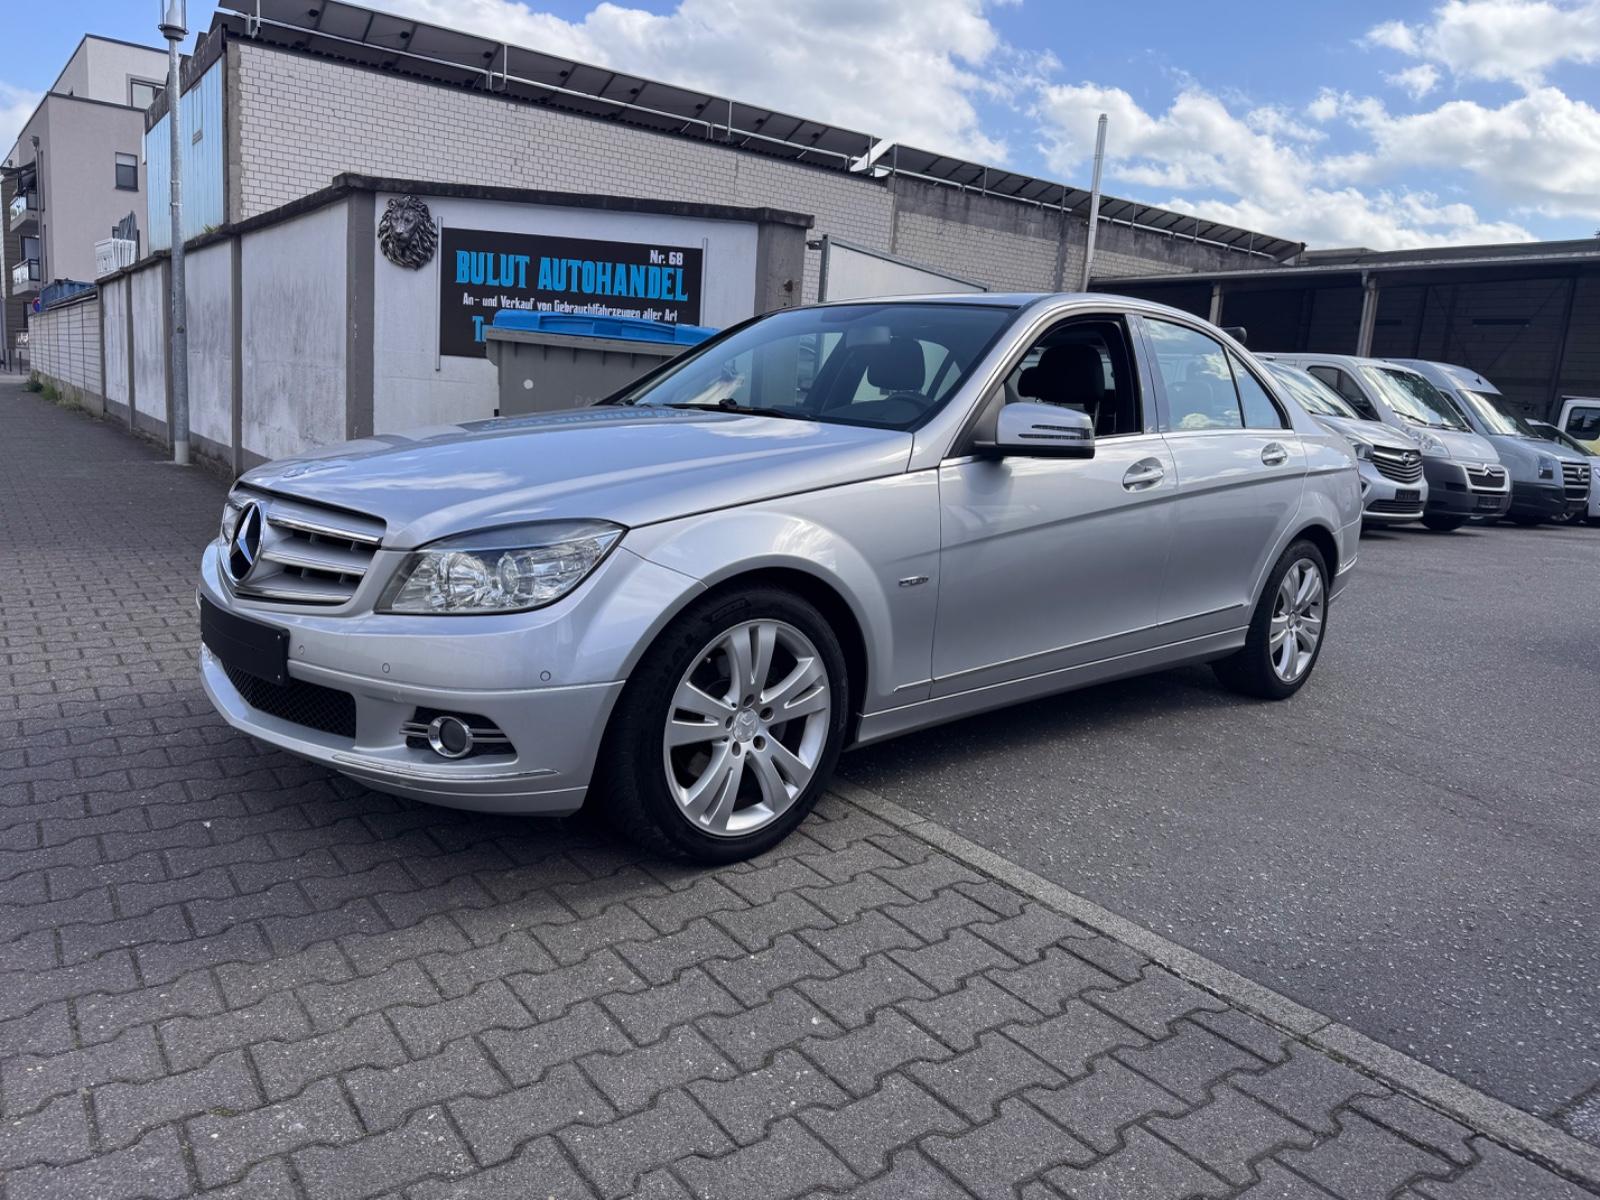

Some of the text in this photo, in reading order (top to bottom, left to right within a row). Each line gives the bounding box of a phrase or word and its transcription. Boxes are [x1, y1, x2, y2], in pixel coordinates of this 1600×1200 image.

[650, 249, 683, 266] Nr. 68
[455, 250, 689, 302] BULUT AUTOHANDEL
[482, 296, 498, 307] und
[500, 295, 535, 310] Verkauf
[537, 301, 552, 312] von
[642, 308, 662, 321] aller
[664, 309, 678, 322] Art
